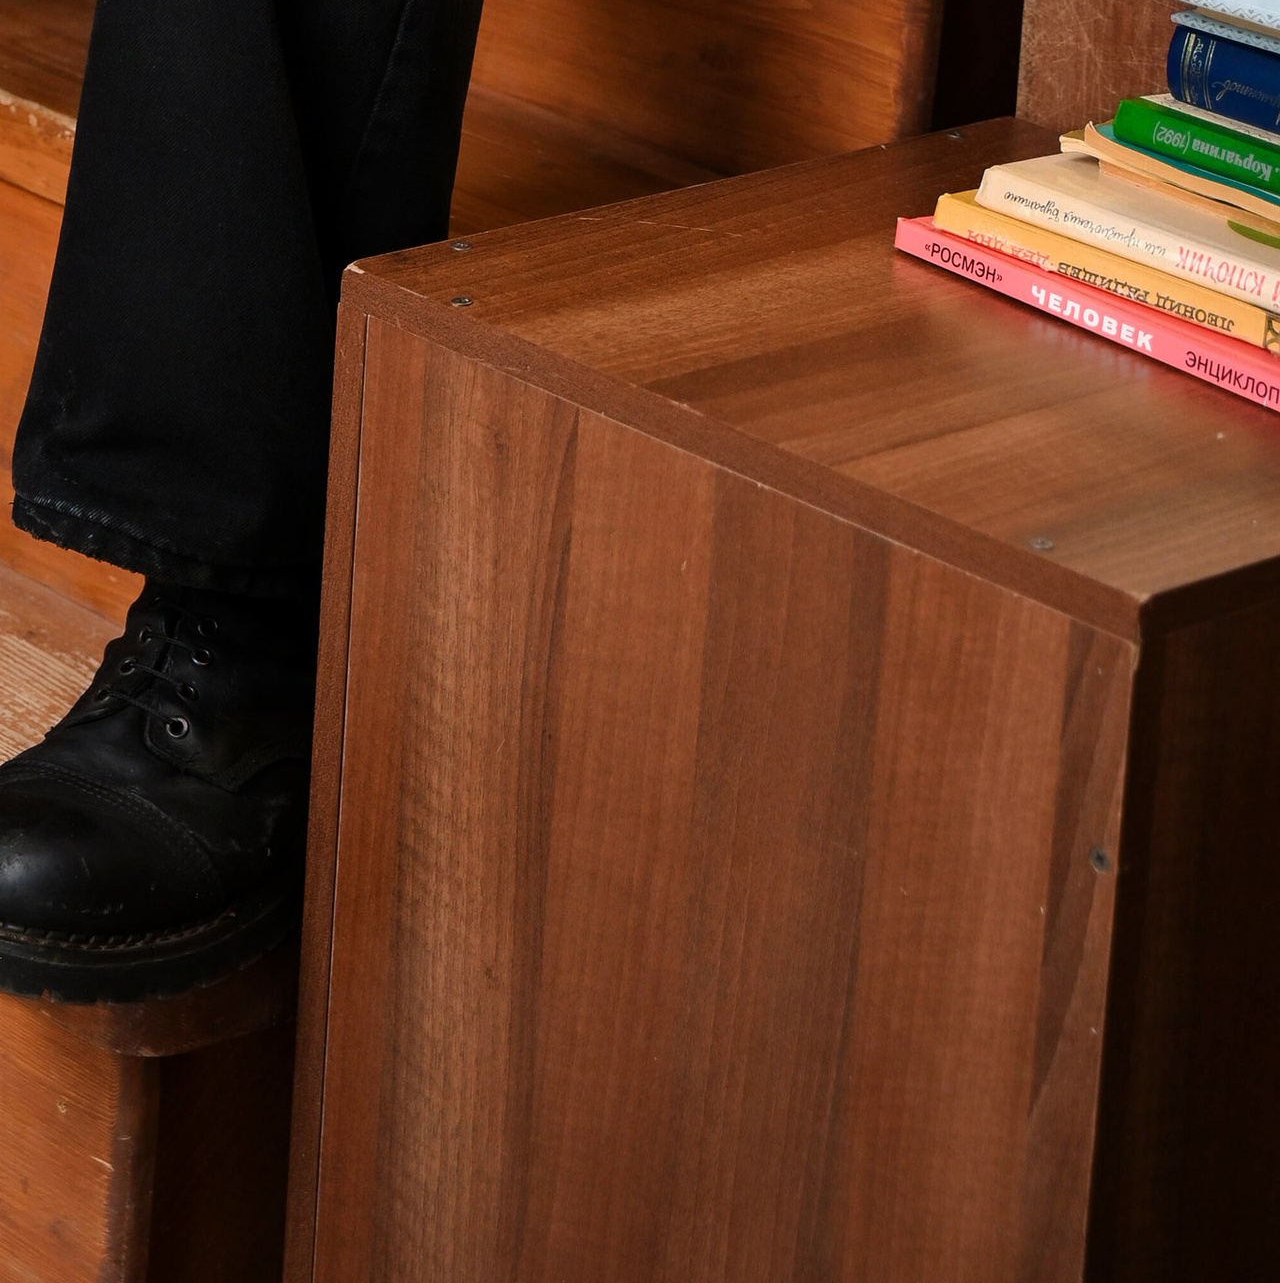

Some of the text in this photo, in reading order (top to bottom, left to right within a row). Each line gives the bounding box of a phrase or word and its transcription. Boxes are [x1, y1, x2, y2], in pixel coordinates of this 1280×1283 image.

[1152, 120, 1273, 182] Корчагина (1992)
[1002, 190, 1060, 223] Буратино
[1009, 246, 1051, 269] ДВА
[1173, 246, 1266, 297] КЛЮЧИК
[1055, 261, 1151, 305] РАДИЩЕВ
[924, 241, 1280, 405] «РОСМЭН» ЧЕЛОВЕК ЭНЦИКЛОП
[1154, 292, 1235, 332] ЛЕОНИД
